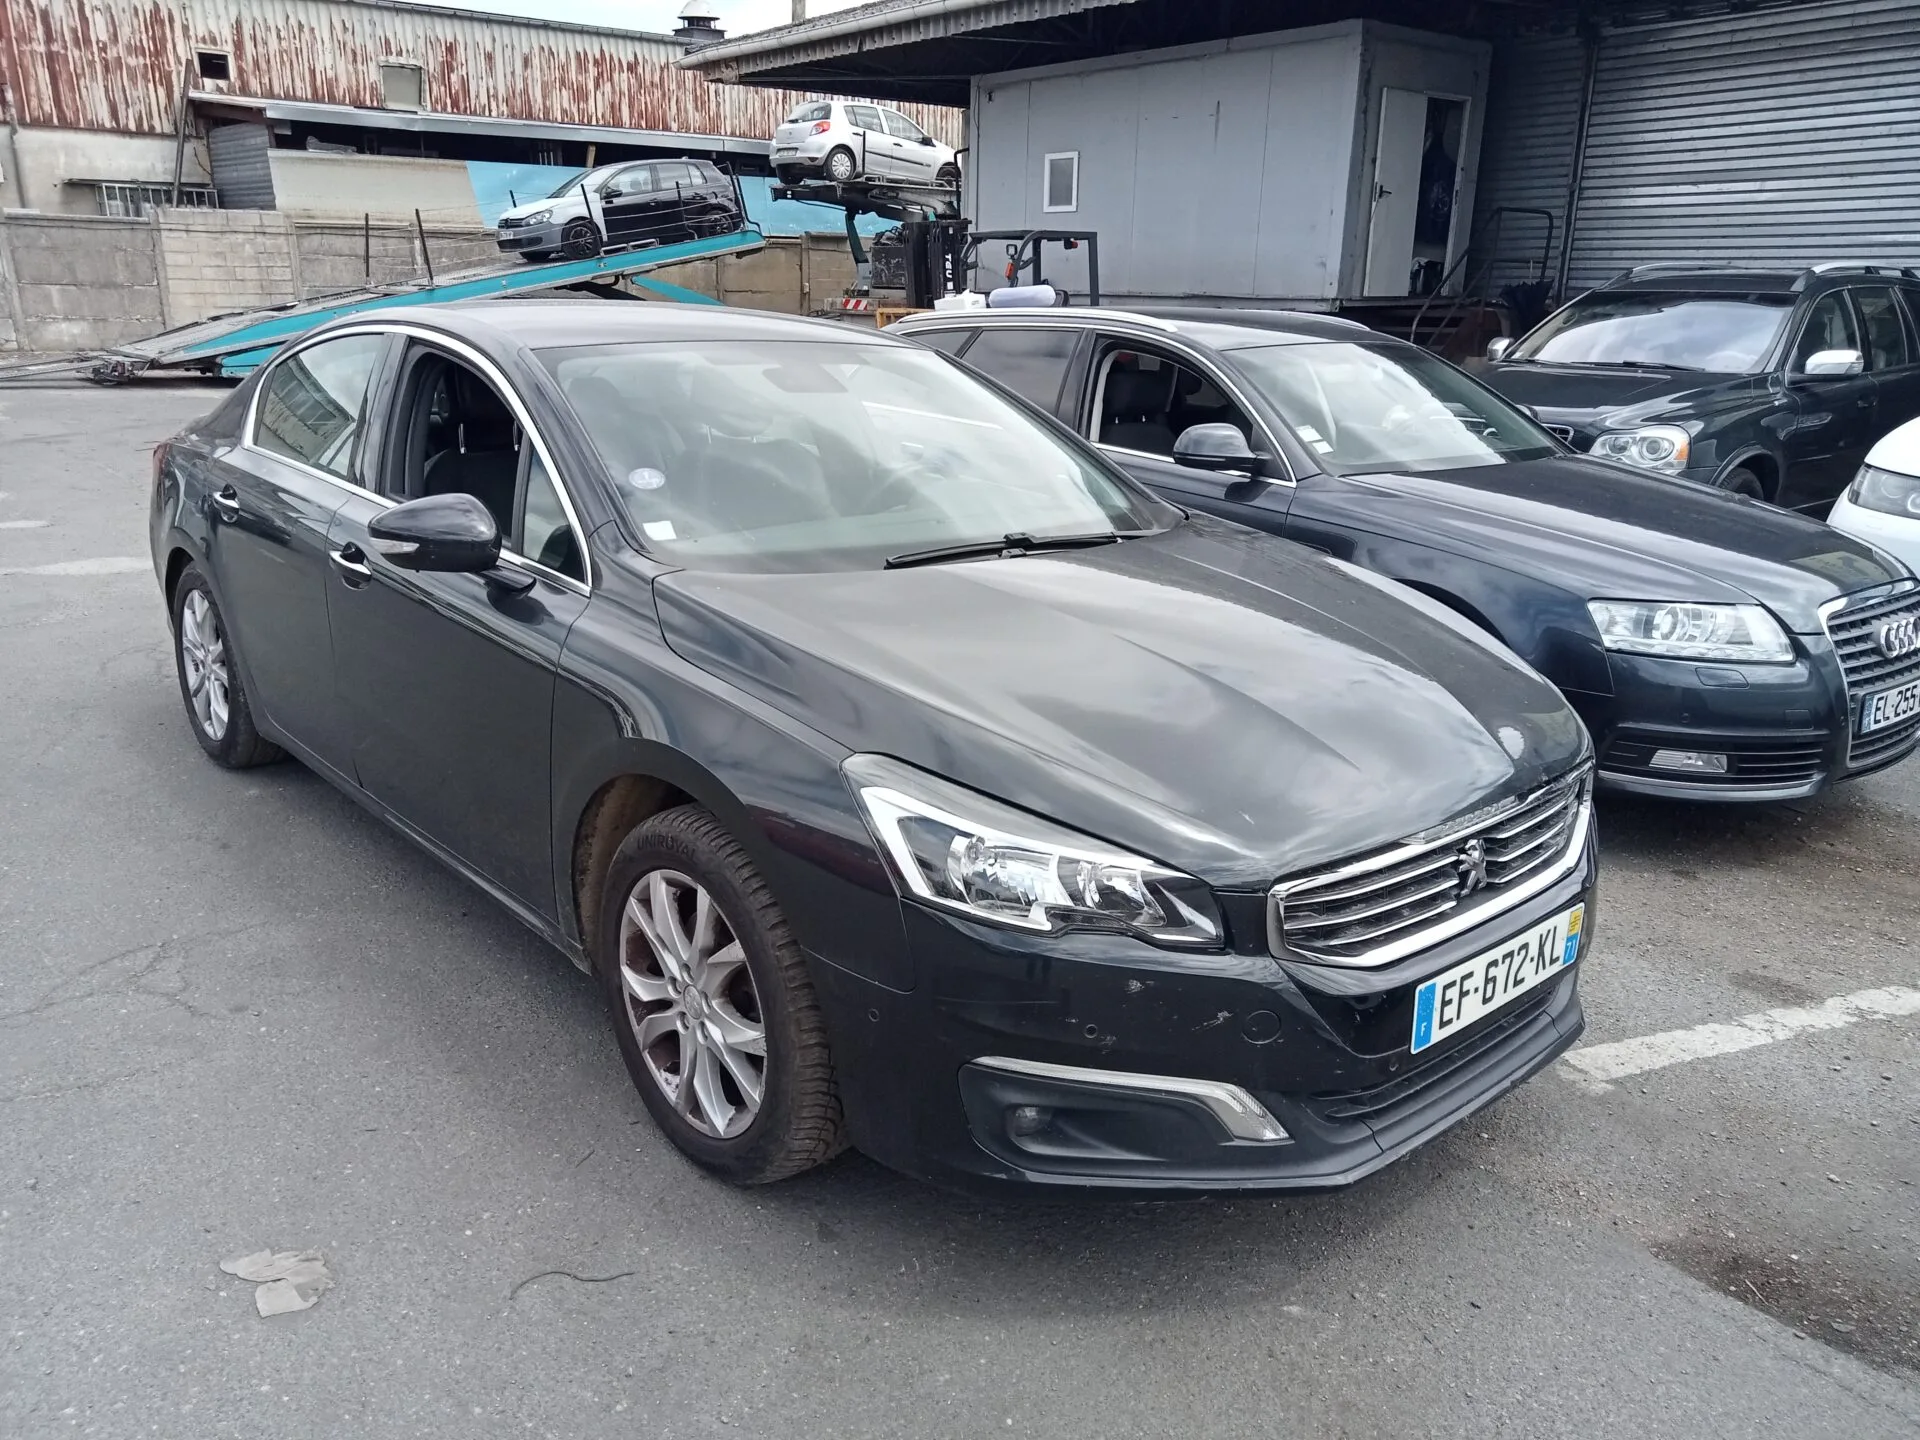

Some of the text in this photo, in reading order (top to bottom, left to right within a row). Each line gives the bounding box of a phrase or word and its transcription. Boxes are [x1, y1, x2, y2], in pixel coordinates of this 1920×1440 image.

[1565, 939, 1576, 960] 71
[1438, 925, 1560, 1031] EF-672-KL
[1420, 1021, 1427, 1037] F
